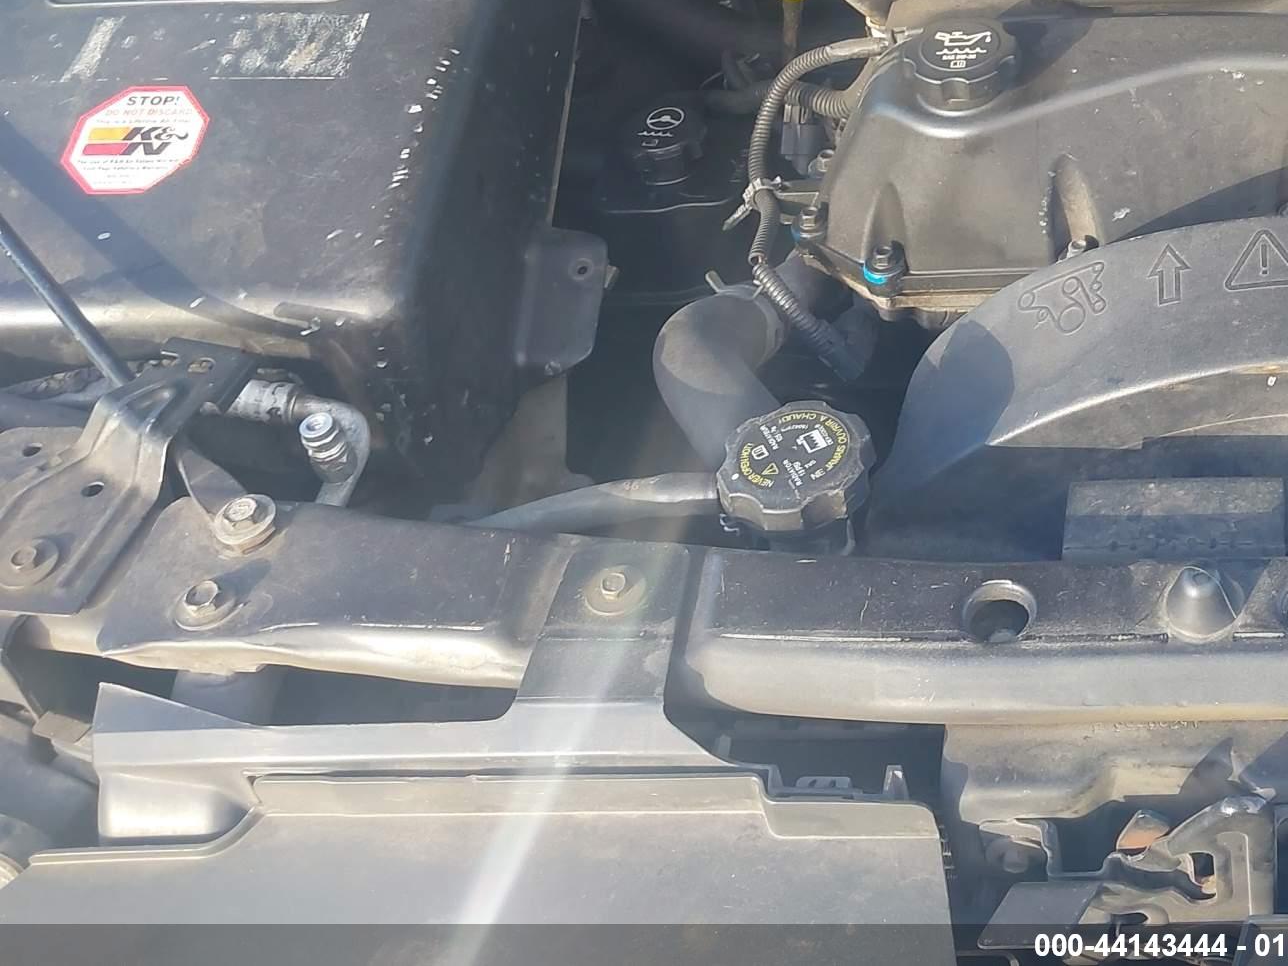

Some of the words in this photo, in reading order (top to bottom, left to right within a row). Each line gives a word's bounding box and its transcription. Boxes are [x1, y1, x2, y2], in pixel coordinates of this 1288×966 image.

[127, 95, 180, 106] STOP!
[123, 108, 145, 116] NOT
[810, 468, 826, 481] NE
[825, 418, 847, 444] OUVRIR
[747, 472, 775, 488] NEVER
[782, 459, 803, 486] RADIATOR
